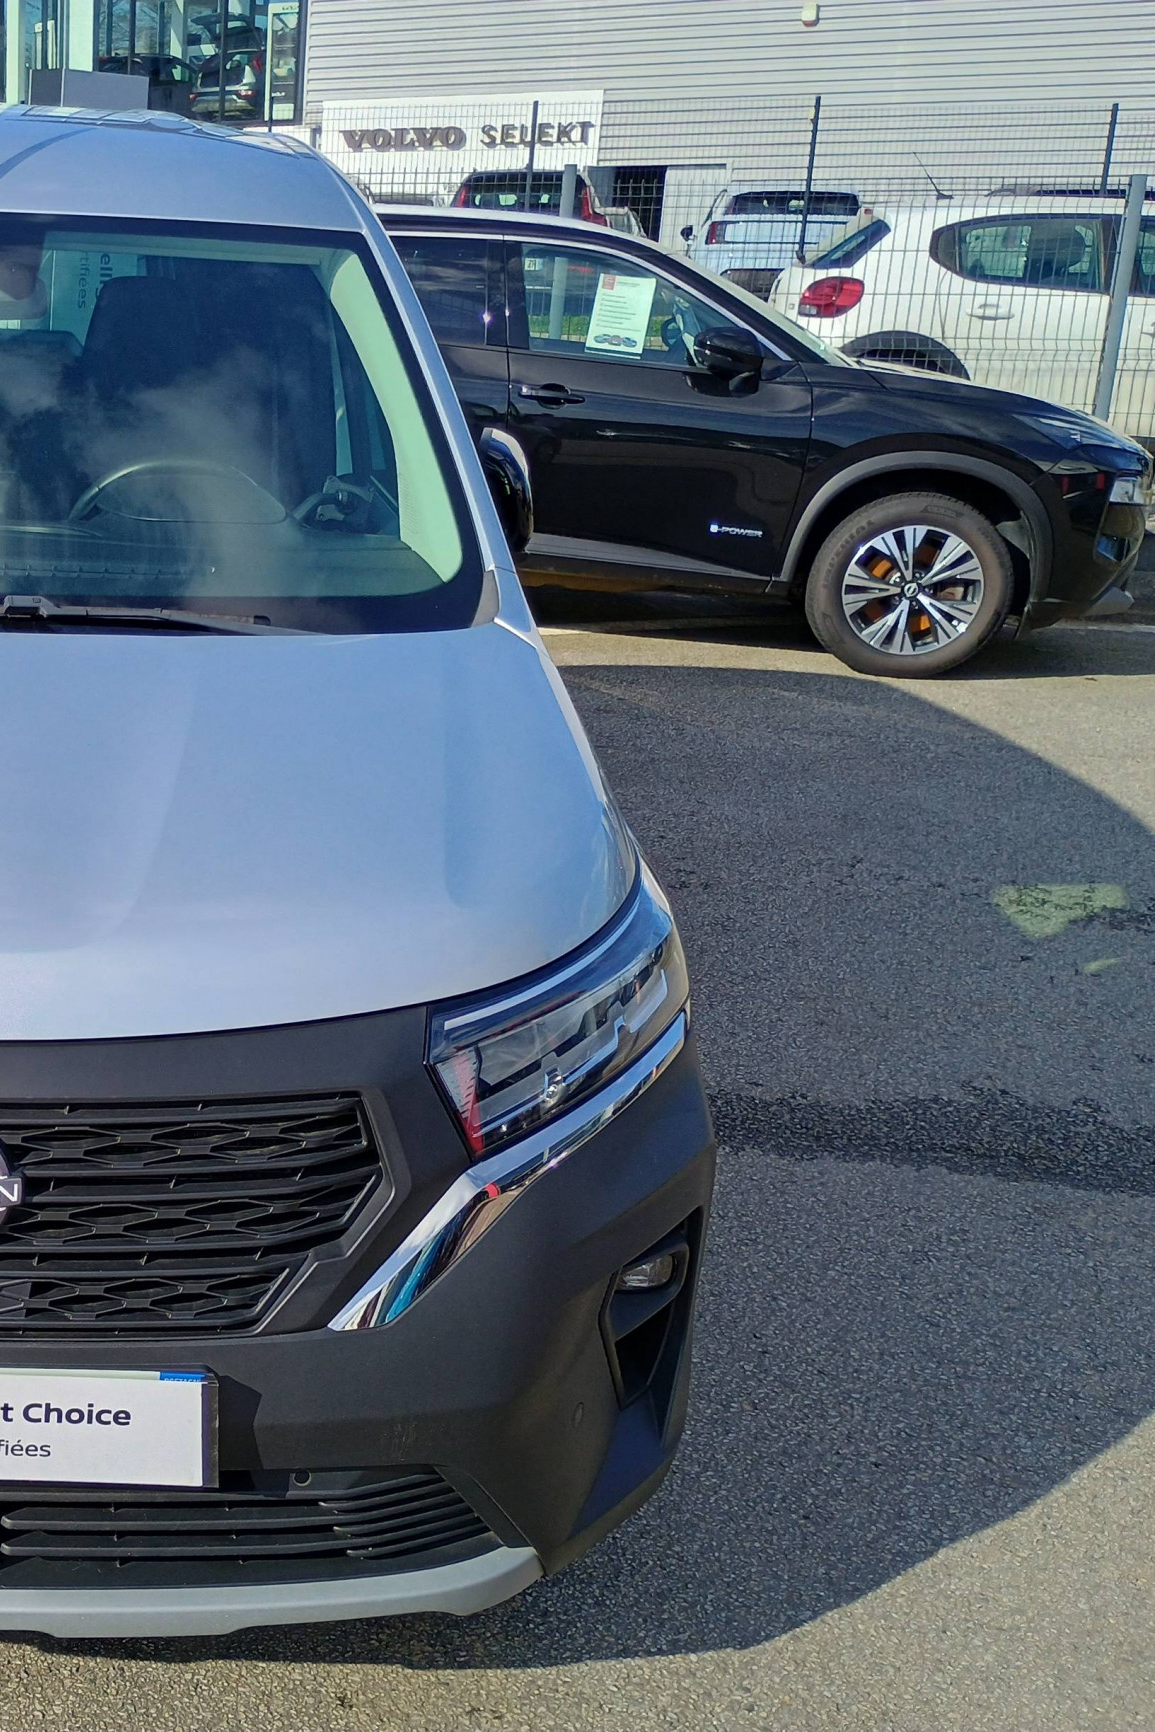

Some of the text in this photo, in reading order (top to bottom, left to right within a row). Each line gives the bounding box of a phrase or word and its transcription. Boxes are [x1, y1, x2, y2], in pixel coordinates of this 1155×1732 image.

[338, 121, 595, 152] VOLVO SELEKT
[22, 1402, 132, 1426] Choice
